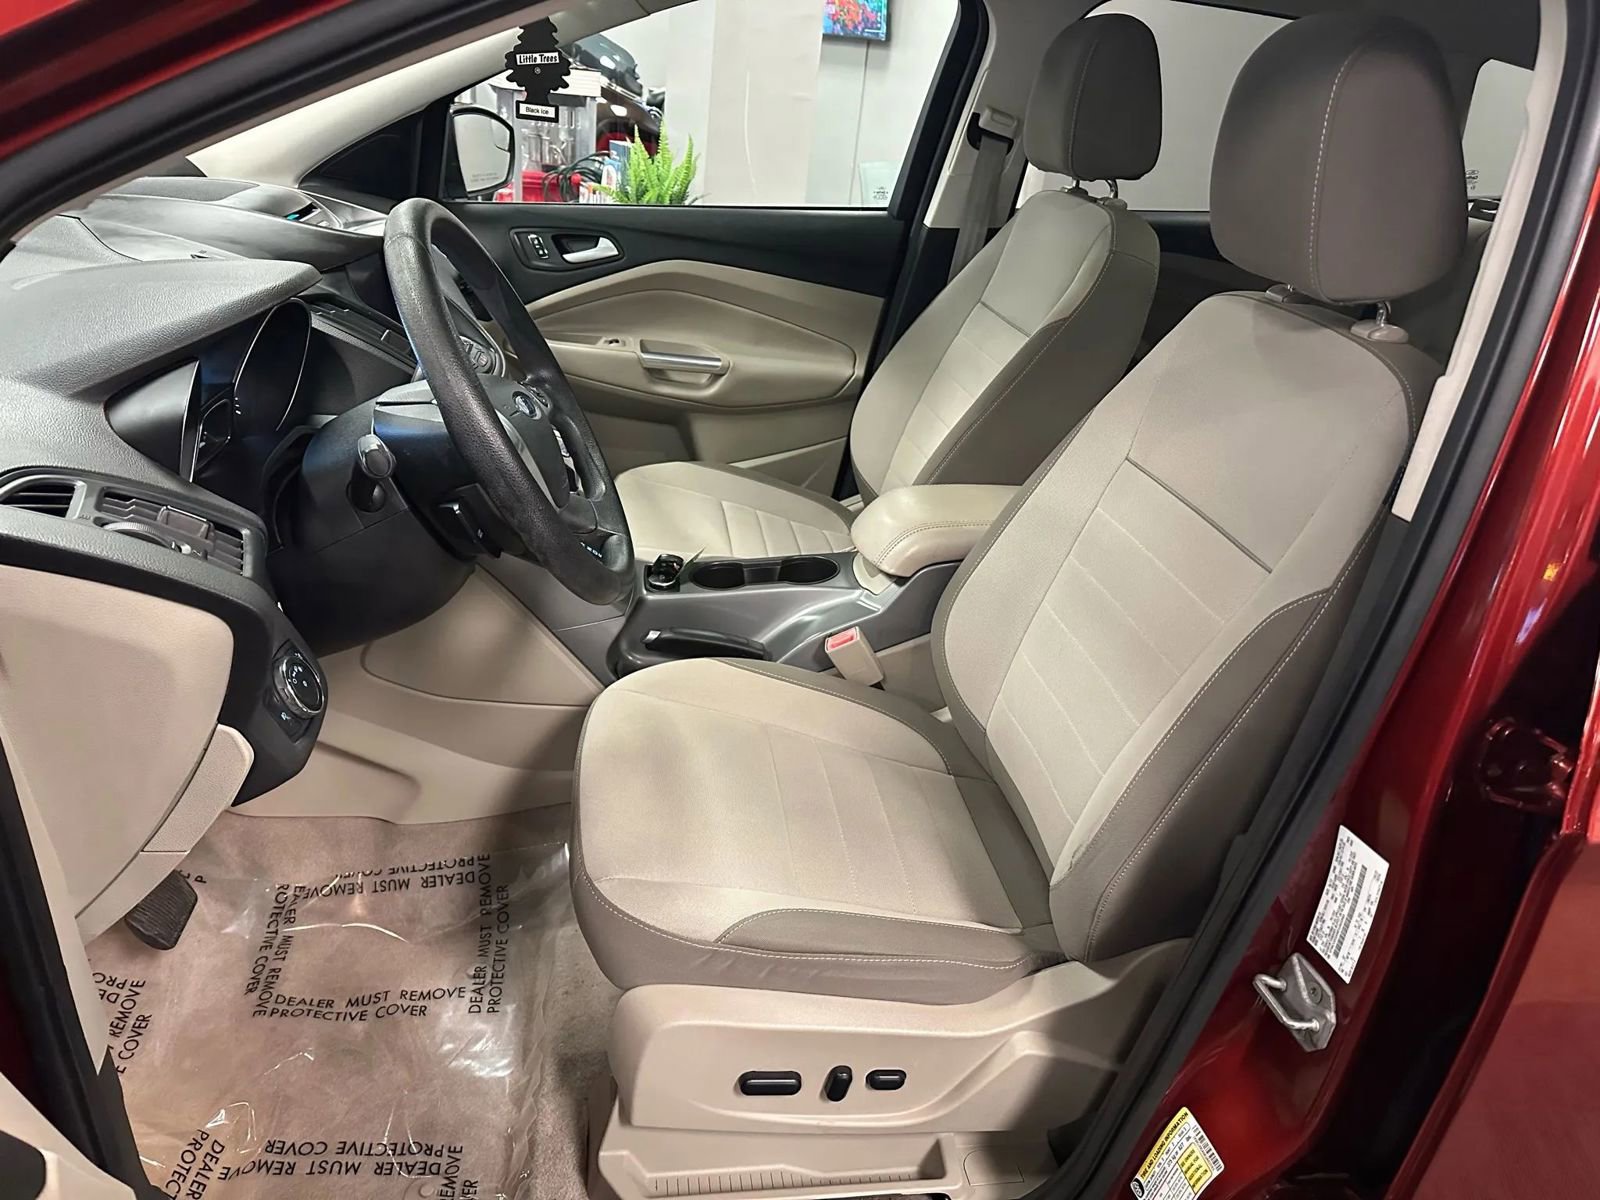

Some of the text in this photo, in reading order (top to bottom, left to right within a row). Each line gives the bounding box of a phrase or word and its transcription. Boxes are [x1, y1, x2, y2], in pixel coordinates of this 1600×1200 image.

[519, 53, 558, 64] Little Trees
[525, 106, 540, 114] Black
[303, 871, 475, 899] DEALER MUST REMOVE
[244, 884, 289, 996] ROTECTIVE COVER
[272, 935, 294, 962] MUST
[468, 853, 492, 1014] DEALER MUST REMOVE
[487, 885, 510, 1014] PROTECTIVE COVER
[108, 980, 146, 1038] REMOVE
[252, 967, 282, 1017] REMOVE
[269, 1003, 428, 1022] PROTECTIVE COVER
[274, 986, 466, 1009] DEALER MUST REMOVE
[118, 1014, 153, 1060] COVER
[264, 1139, 444, 1158] PROTECTIVE COVER
[1140, 1168, 1148, 1179] TIRE
[1147, 1159, 1155, 1169] AND
[1152, 1141, 1166, 1161] LOADING
[1165, 1111, 1189, 1142] INFORMATION
[186, 1139, 225, 1200] DEALER
[217, 1159, 441, 1181] DEALER MUST REMOVE
[440, 1145, 464, 1200] EMOVE
